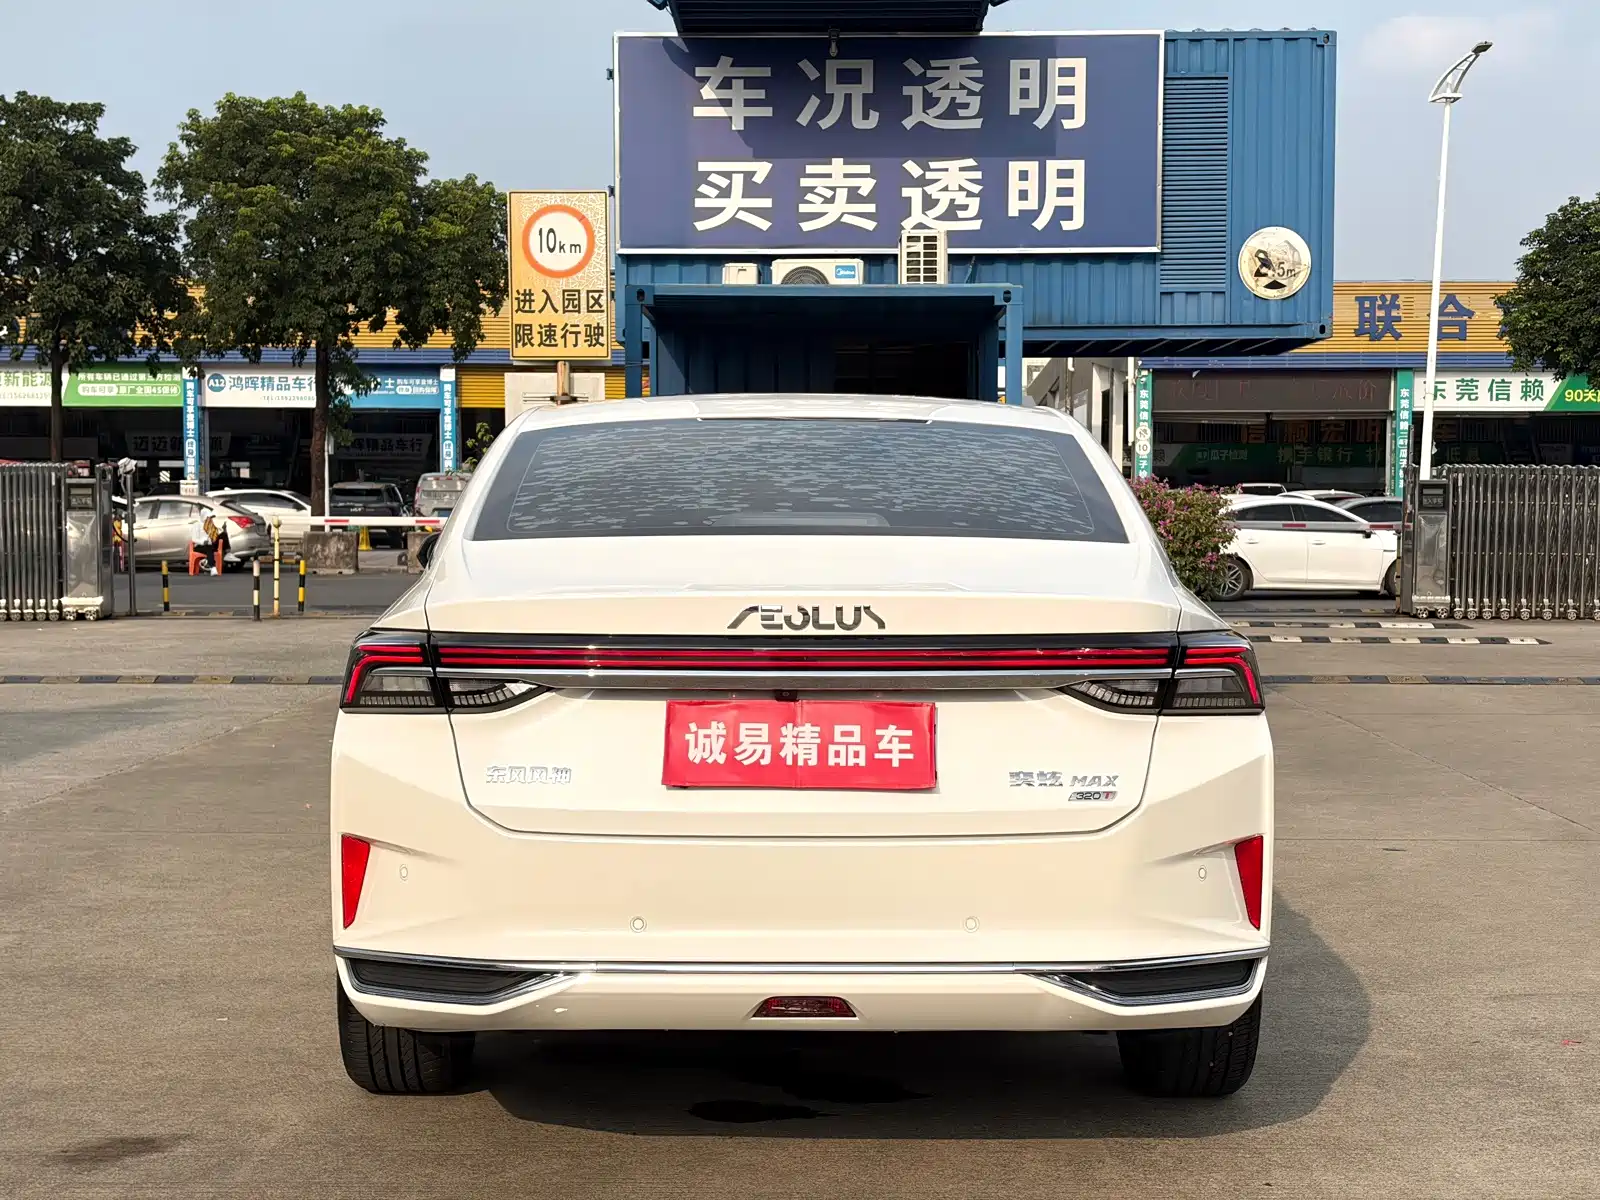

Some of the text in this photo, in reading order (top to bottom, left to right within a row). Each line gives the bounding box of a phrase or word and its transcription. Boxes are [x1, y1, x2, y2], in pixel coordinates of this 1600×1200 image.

[693, 56, 1088, 131] 车况透明
[693, 158, 1087, 232] 买卖透明
[514, 289, 605, 314] 进入园区
[1354, 293, 1508, 341] 联合
[514, 323, 605, 348] 限速行驶
[0, 370, 52, 387] 新能源
[208, 377, 226, 388] A12
[1422, 378, 1544, 402] 东莞信赖
[685, 720, 915, 768] 诚易精品车
[1069, 775, 1120, 787] MAX
[1075, 791, 1114, 801] 320T
